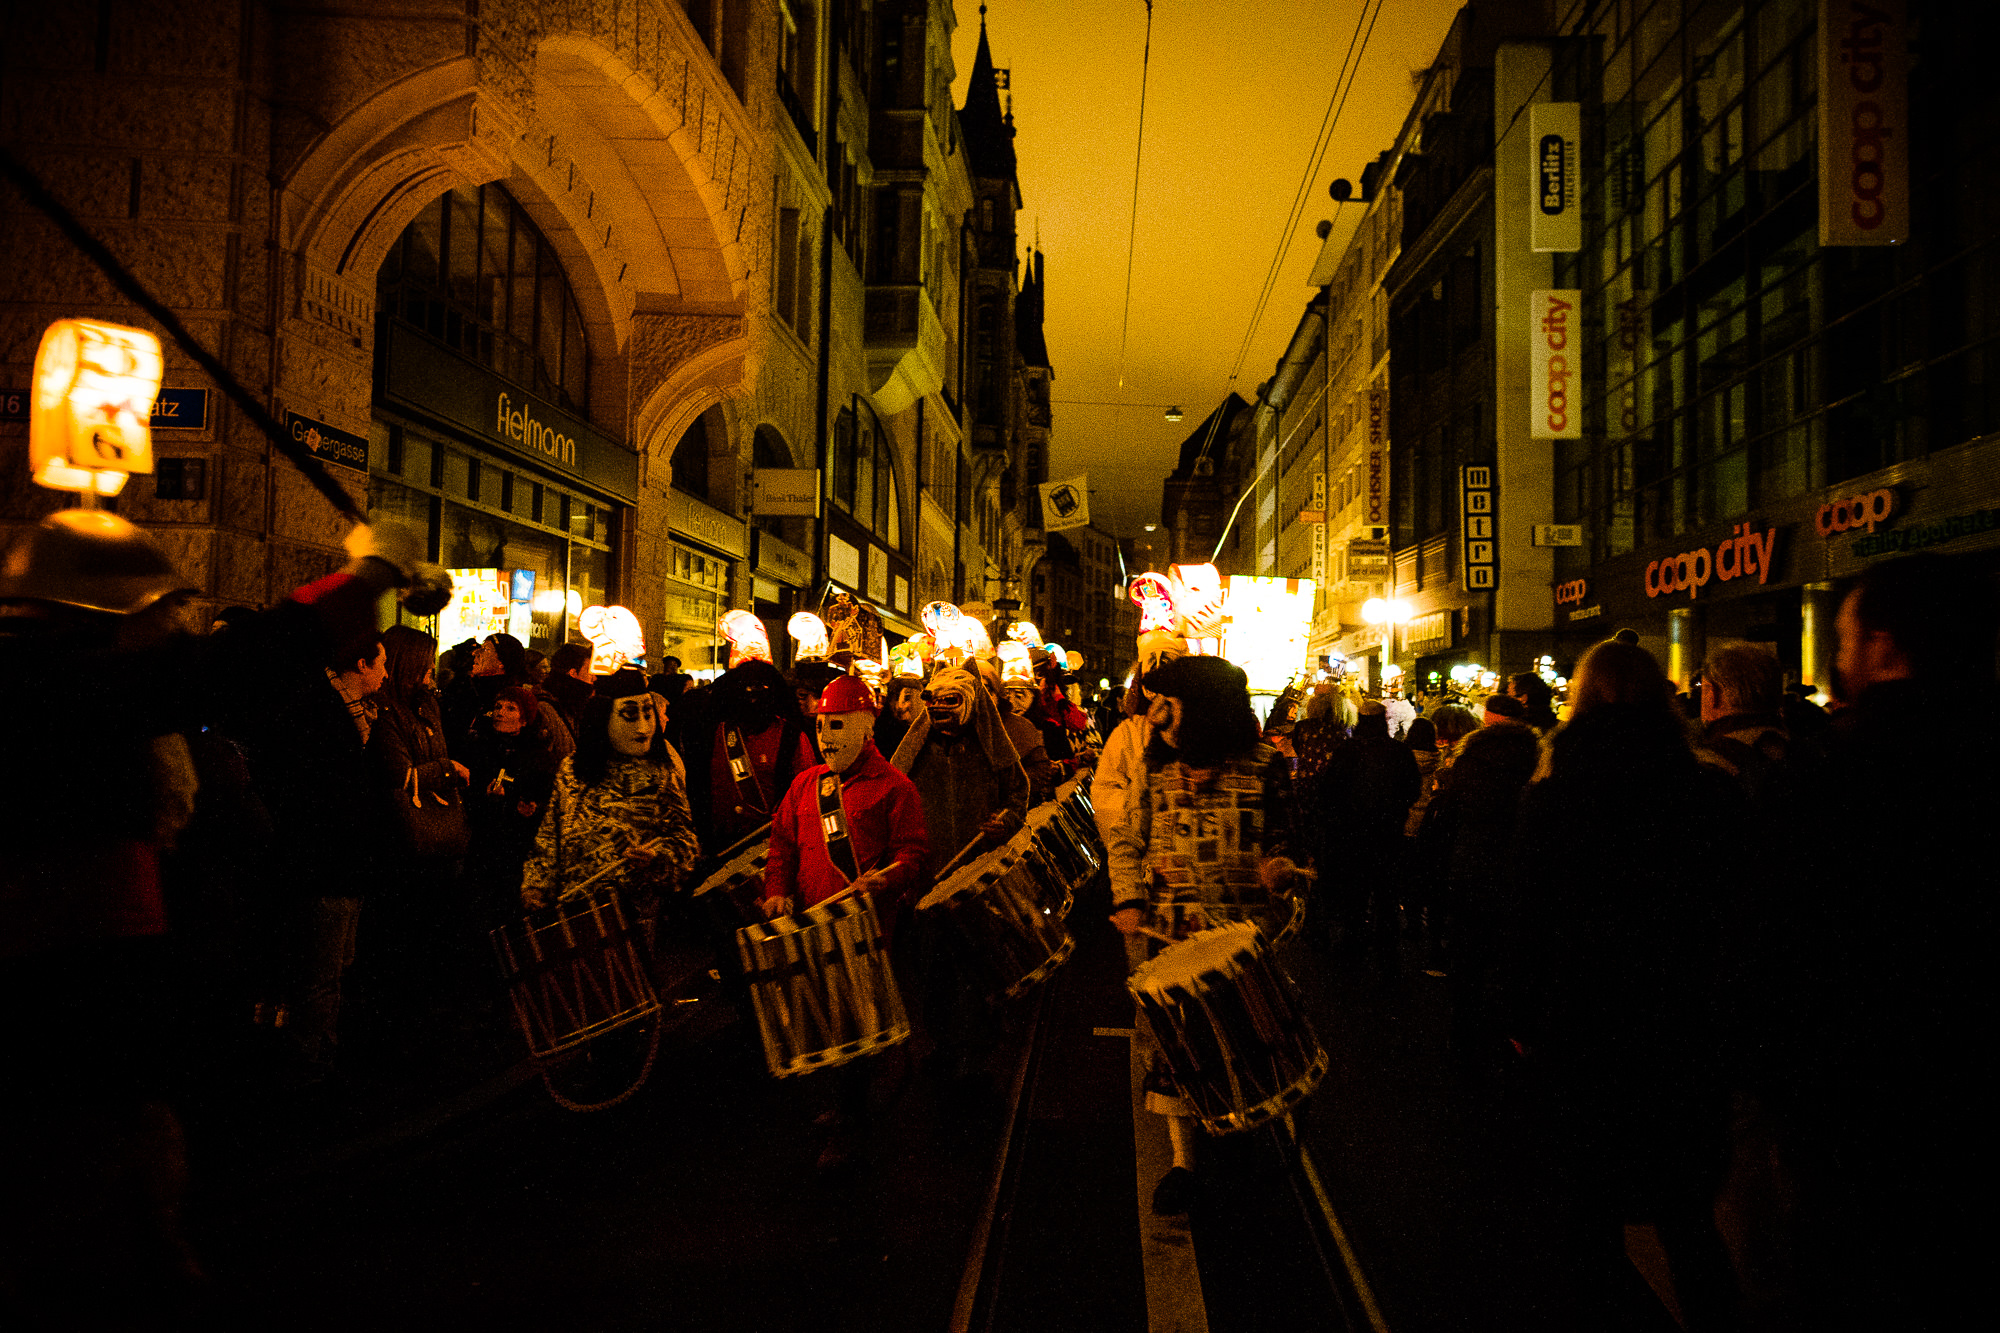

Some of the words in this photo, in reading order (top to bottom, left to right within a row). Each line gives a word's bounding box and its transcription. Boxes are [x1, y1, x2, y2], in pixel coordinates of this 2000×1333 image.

[1840, 0, 1893, 94] city
[1542, 141, 1561, 208] Berlitz
[1852, 101, 1893, 230] coop
[1541, 296, 1572, 350] city
[150, 397, 181, 417] atz
[1368, 393, 1382, 445] SHOES
[1547, 353, 1570, 431] coop
[291, 420, 366, 463] Gebergasse
[496, 391, 576, 468] fielmann
[1316, 475, 1325, 509] KINO
[1368, 450, 1382, 522] OCHSNER
[1815, 488, 1894, 538] coop
[1315, 525, 1324, 587] CENTRAL
[1644, 546, 1713, 600] coop
[1716, 521, 1777, 585] city
[1556, 578, 1587, 606] coop
